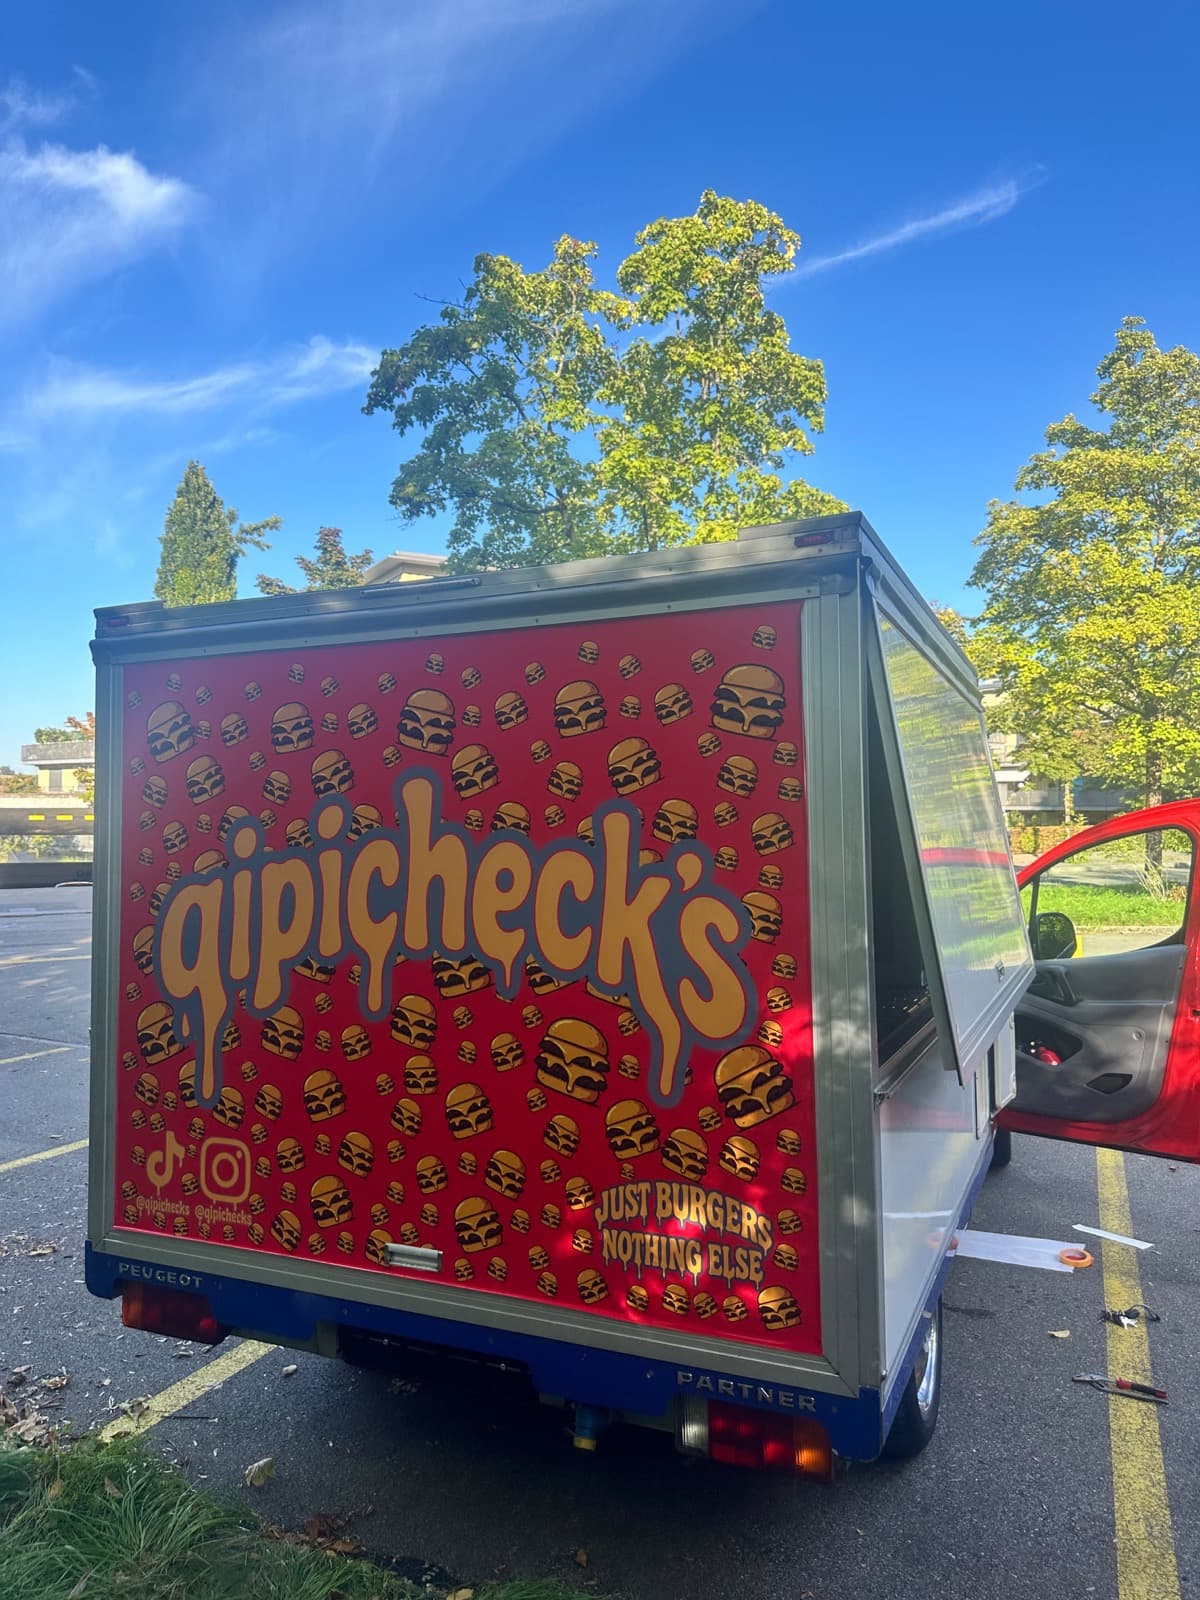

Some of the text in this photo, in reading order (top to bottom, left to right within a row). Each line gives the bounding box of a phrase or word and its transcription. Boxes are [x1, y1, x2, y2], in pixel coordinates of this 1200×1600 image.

[595, 1181, 773, 1253] JUST BURGERS
[119, 1262, 203, 1288] PEUGEOT
[602, 1229, 765, 1289] NOTHING ELSE
[677, 1371, 816, 1412] PARTNER
